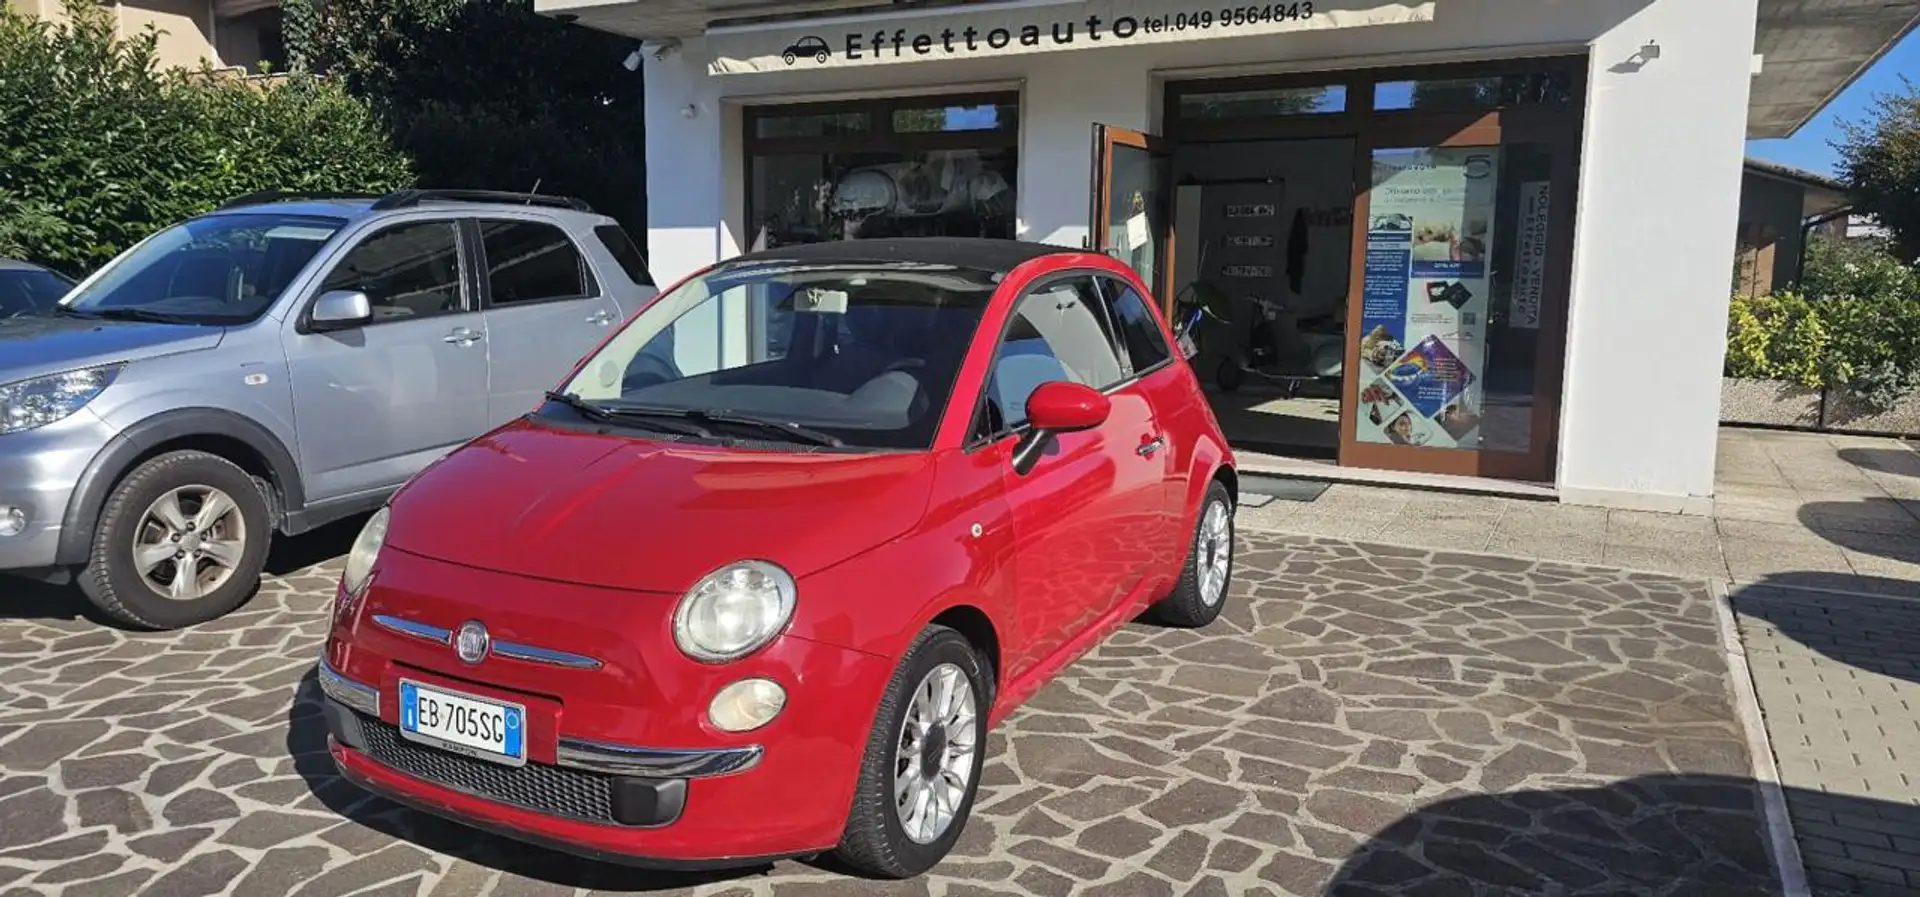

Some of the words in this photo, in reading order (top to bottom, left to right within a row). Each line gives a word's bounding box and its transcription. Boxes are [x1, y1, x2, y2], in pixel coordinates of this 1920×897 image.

[846, 15, 1138, 59] Effettoauto
[1220, 2, 1313, 27] 9564843
[1534, 185, 1549, 257] NOLEGGIO
[1527, 268, 1541, 324] VENDITA
[418, 697, 439, 727] EB
[445, 703, 504, 743] 705SG
